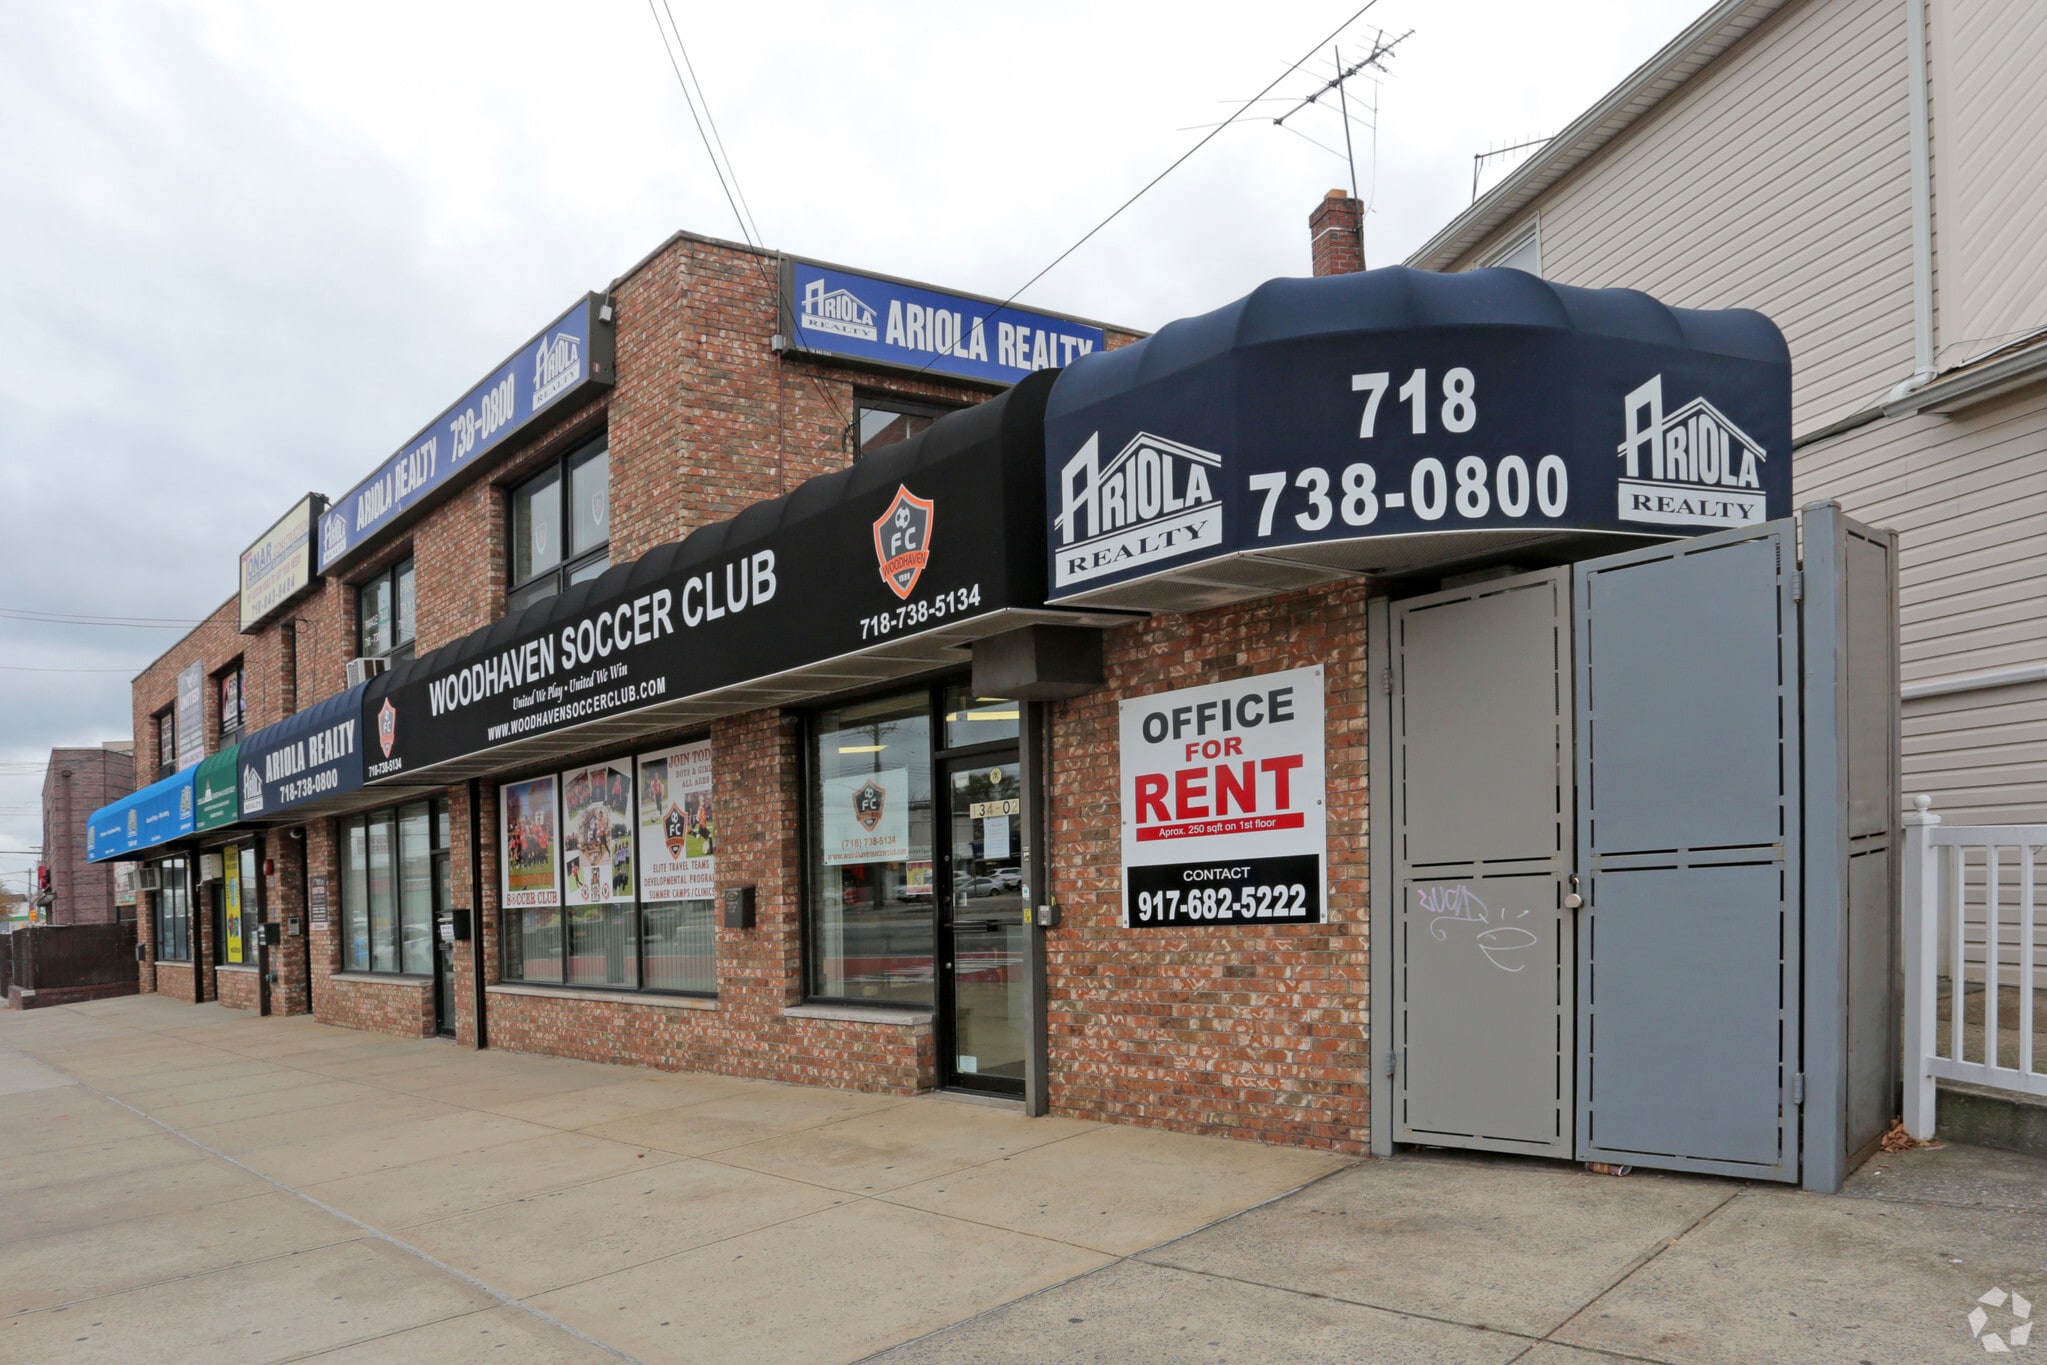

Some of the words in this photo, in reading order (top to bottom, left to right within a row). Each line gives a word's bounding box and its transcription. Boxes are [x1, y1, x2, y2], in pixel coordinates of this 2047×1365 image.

[805, 278, 874, 327] ARIOLA
[808, 319, 872, 337] REALTY
[886, 300, 988, 362] ARIOLA
[998, 321, 1094, 372] REALTY
[535, 335, 579, 391] ARIOLA
[537, 371, 575, 403] REALTY
[1351, 366, 1477, 439] 718
[1622, 373, 1760, 489] ARIOLA
[356, 472, 393, 532] ARIOLA
[394, 435, 437, 503] REALTY
[450, 372, 515, 464] 738-0800
[1058, 430, 1214, 545] ARIOLA
[1249, 454, 1569, 537] 738-0800
[1630, 493, 1755, 520] REALTY
[890, 526, 917, 556] FC
[1067, 519, 1209, 575] REALTY
[882, 552, 926, 577] WOODHAVEN
[859, 583, 981, 640] 718-738-5134
[429, 633, 555, 717] WOODHAVEN
[561, 588, 674, 670] SOCCER
[682, 549, 777, 628] CLUB
[512, 692, 537, 711] United
[535, 690, 547, 704] We
[547, 684, 564, 703] Play
[569, 669, 595, 693] United
[596, 668, 609, 684] We
[609, 662, 628, 680] Win
[487, 676, 667, 741] WWW.WOODHAVENSOCCERCLUB.COM
[1142, 686, 1295, 744] OFFICE
[265, 740, 306, 784] ARIOLA
[308, 718, 356, 768] REALTY
[668, 752, 690, 769] JOIN
[691, 748, 712, 764] TOD
[1185, 736, 1243, 762] FOR
[368, 757, 402, 778] 718-738-5134
[675, 768, 691, 779] BOYS
[691, 767, 697, 776] &
[697, 765, 712, 775] GIRL
[682, 778, 693, 788] ALL
[694, 775, 710, 786] AGES
[279, 767, 339, 804] 718-738-0800
[1134, 753, 1304, 825] RENT
[861, 798, 877, 811] FC
[669, 823, 681, 837] FC
[841, 838, 862, 850] (718)
[864, 835, 897, 847] 738-5134
[1158, 828, 1186, 838] Aprox.
[1188, 824, 1205, 835] 250
[1206, 822, 1223, 834] sqft
[1224, 822, 1237, 831] on
[1239, 820, 1253, 829] 1st
[1255, 818, 1277, 828] floor
[643, 875, 688, 887] DEVELOPMENTAL
[689, 873, 715, 884] PROGRA
[652, 863, 667, 873] ELITE
[669, 861, 689, 872] TRAVEL
[691, 859, 710, 870] TEAMS
[1183, 866, 1251, 882] CONTACT
[506, 892, 536, 906] SOCCER
[537, 890, 558, 905] CLUB
[649, 889, 671, 900] SUMMER
[1138, 883, 1306, 921] 917-682-5222
